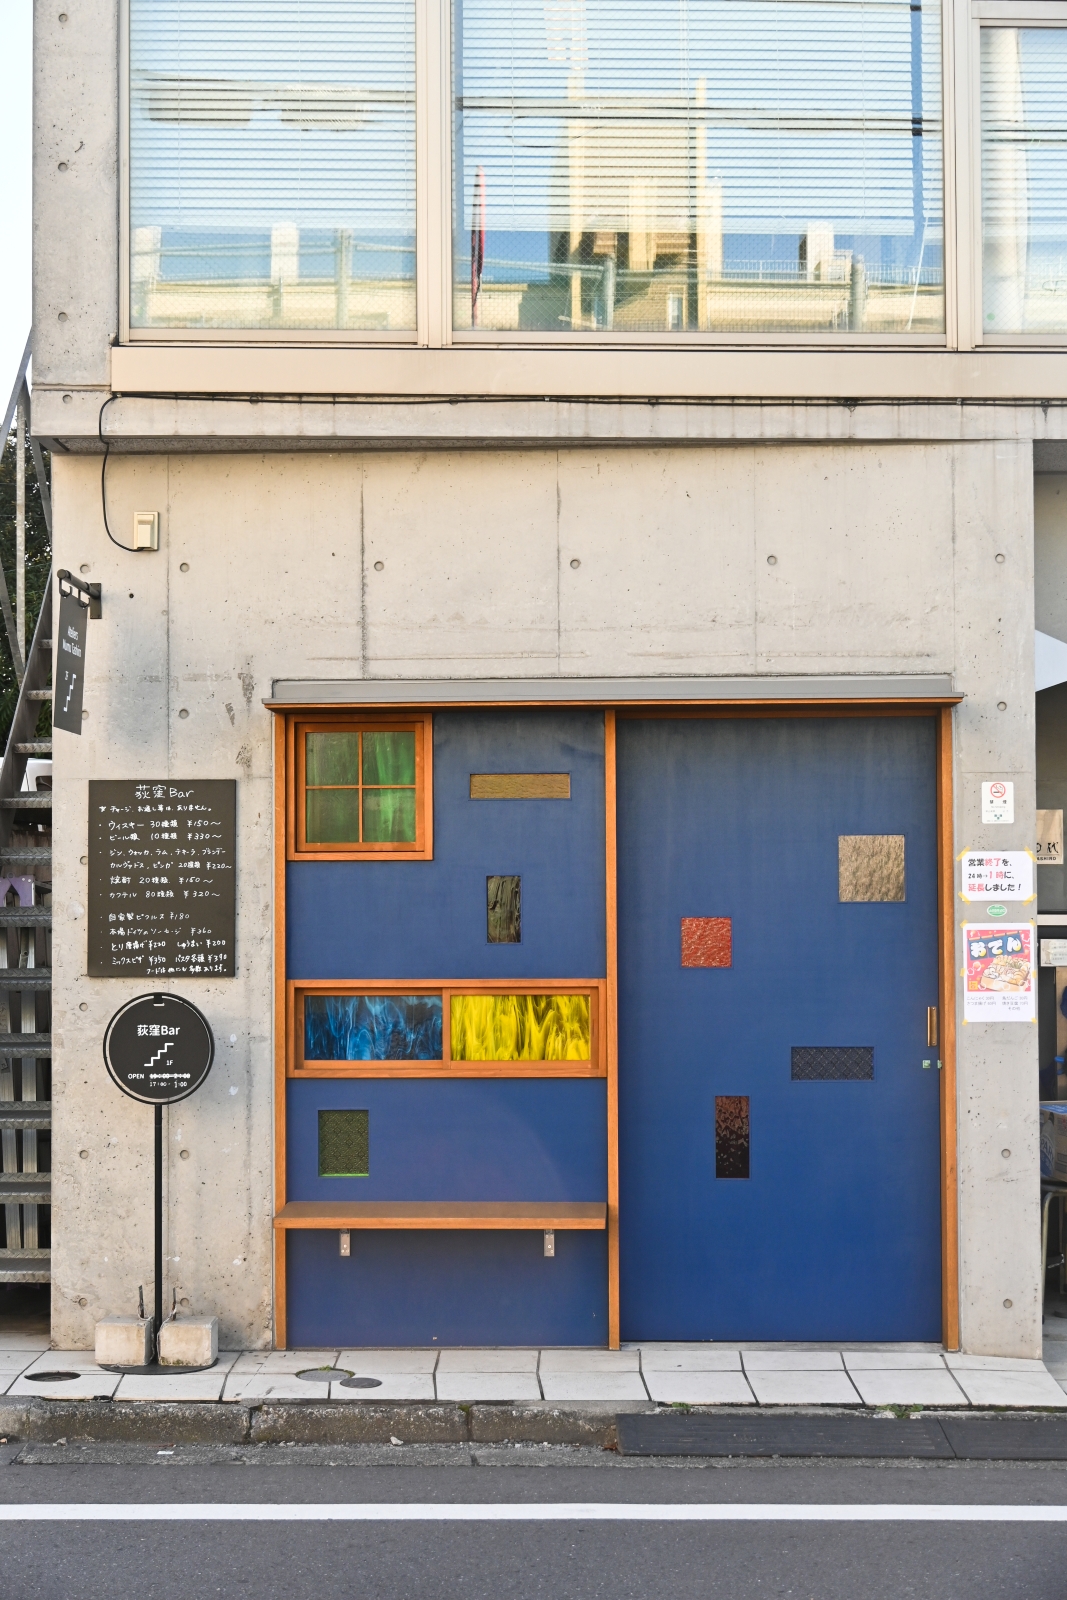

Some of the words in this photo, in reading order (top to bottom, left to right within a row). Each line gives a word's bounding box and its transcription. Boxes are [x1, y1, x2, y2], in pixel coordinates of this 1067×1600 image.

[135, 784, 194, 799] 荻窪Bar
[109, 821, 144, 830] ウィスキー
[137, 1024, 180, 1036] 荻窪Bar
